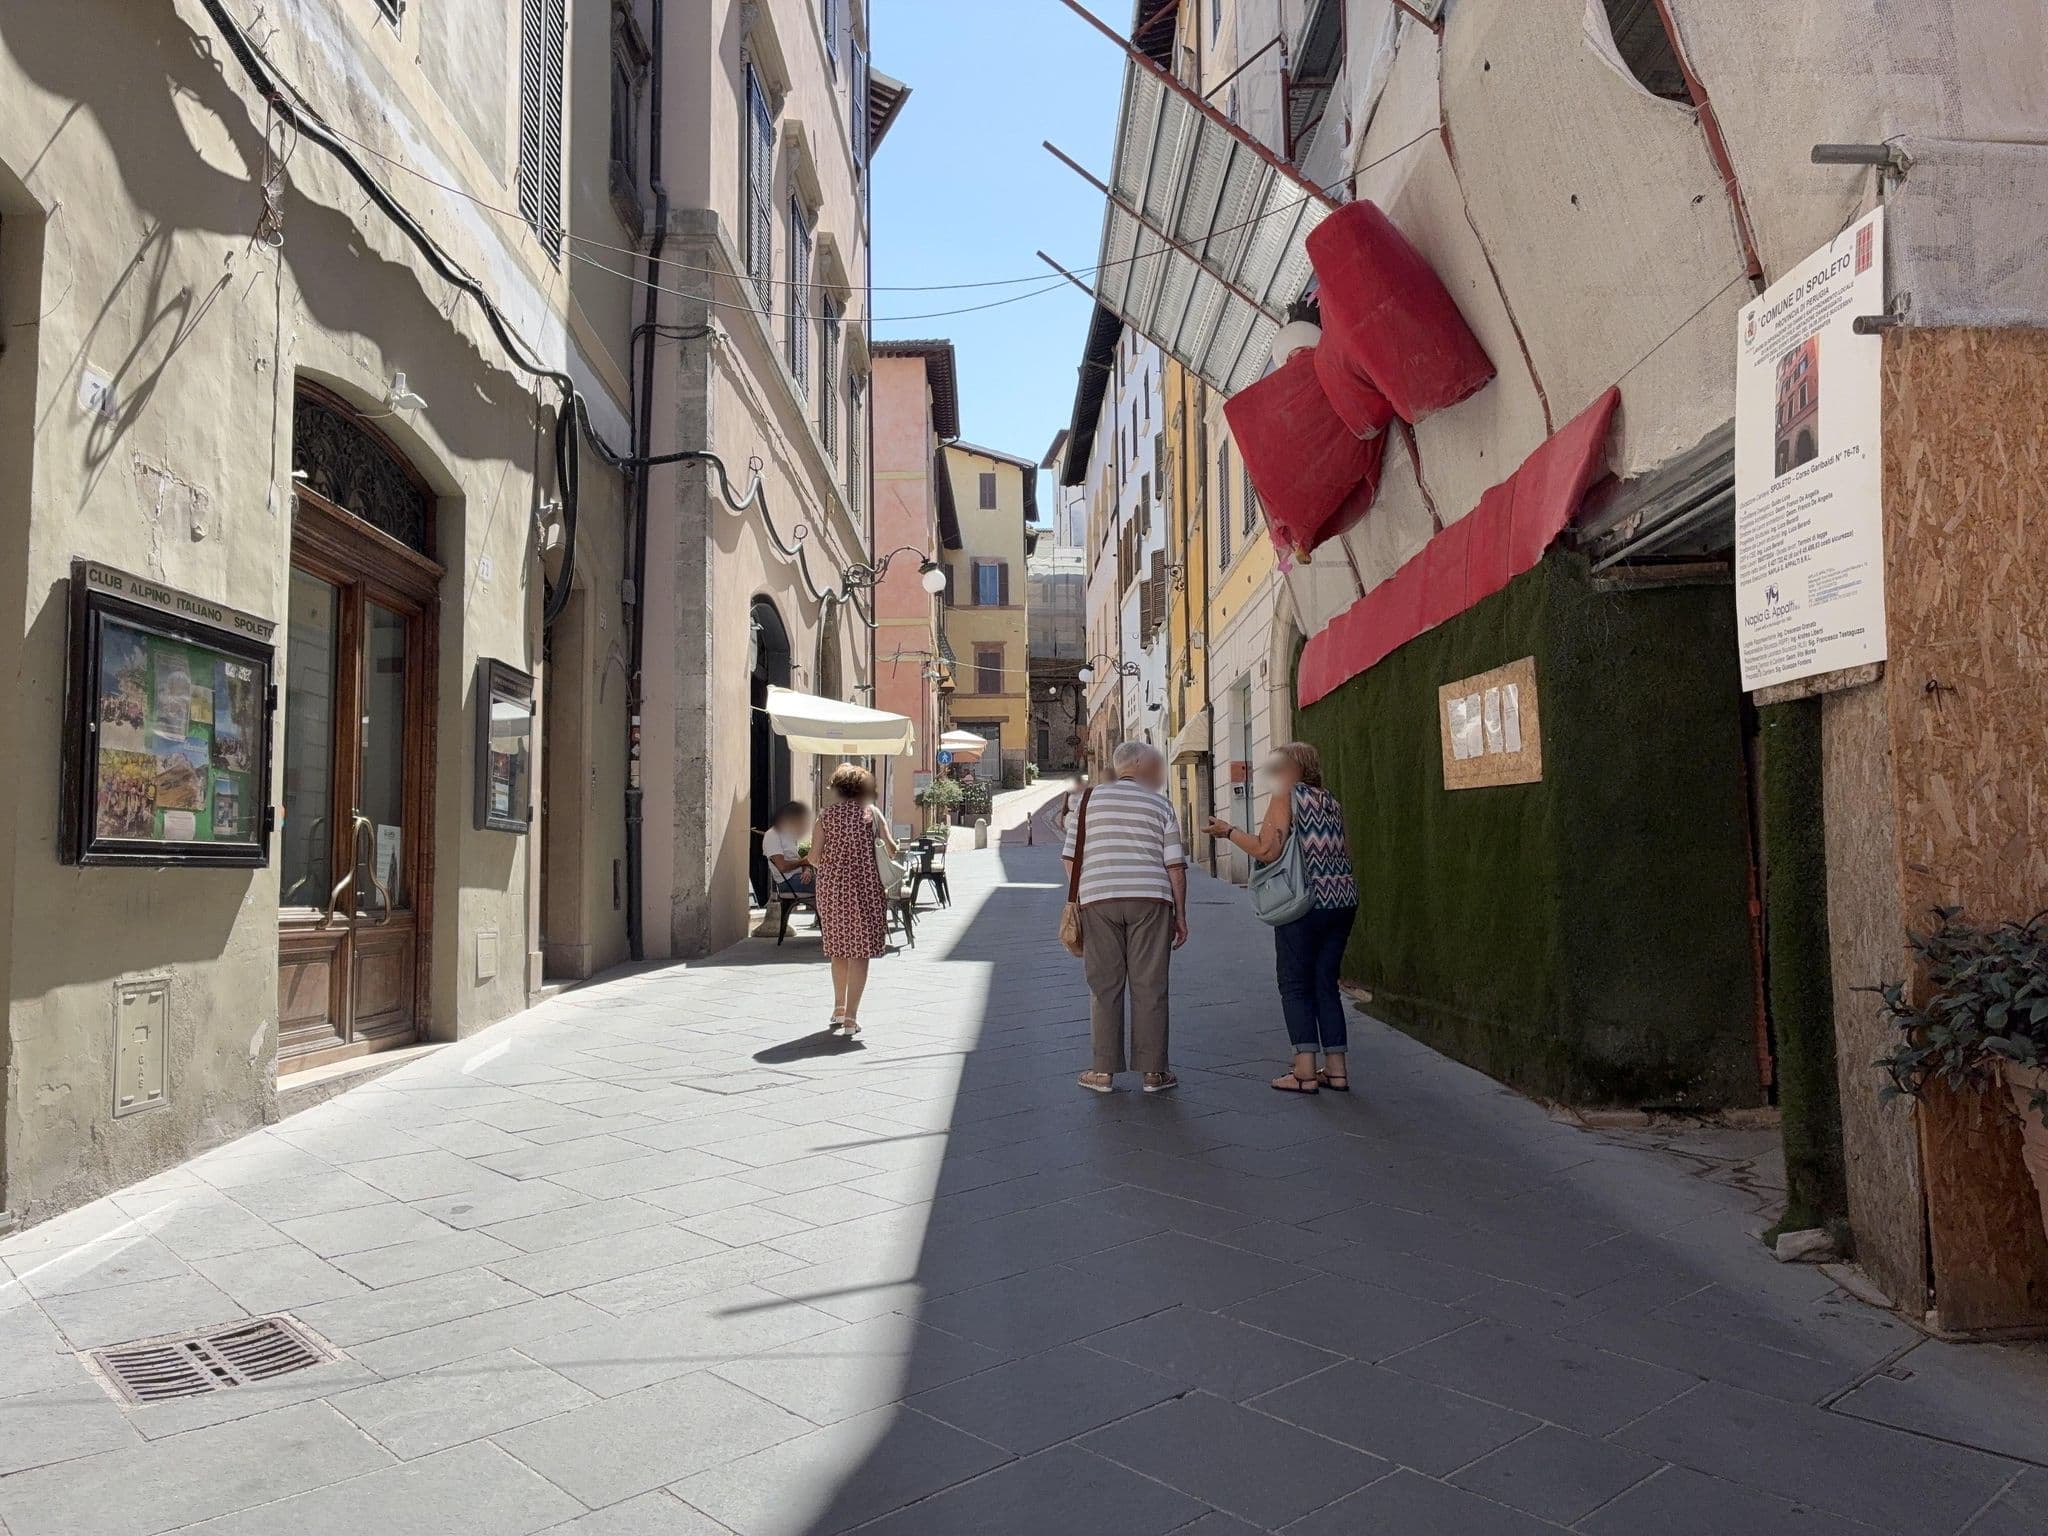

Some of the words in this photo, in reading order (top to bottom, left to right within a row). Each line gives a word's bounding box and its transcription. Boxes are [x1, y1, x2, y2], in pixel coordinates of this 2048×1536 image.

[1760, 292, 1794, 327] COMUNE
[1796, 287, 1804, 301] DI
[1806, 253, 1851, 294] SPOLETO
[1775, 307, 1800, 329] PROVINCIA
[1806, 287, 1829, 306] PERUGIA
[1770, 477, 1791, 493] SPOLETO
[1795, 469, 1810, 481] Corso
[1810, 456, 1834, 473] Garibaldi
[89, 569, 122, 590] CLUB
[130, 582, 171, 605] ALPINO
[176, 597, 222, 622] ITALIANO
[1744, 613, 1763, 626] Napla
[1772, 600, 1795, 618] Appalti
